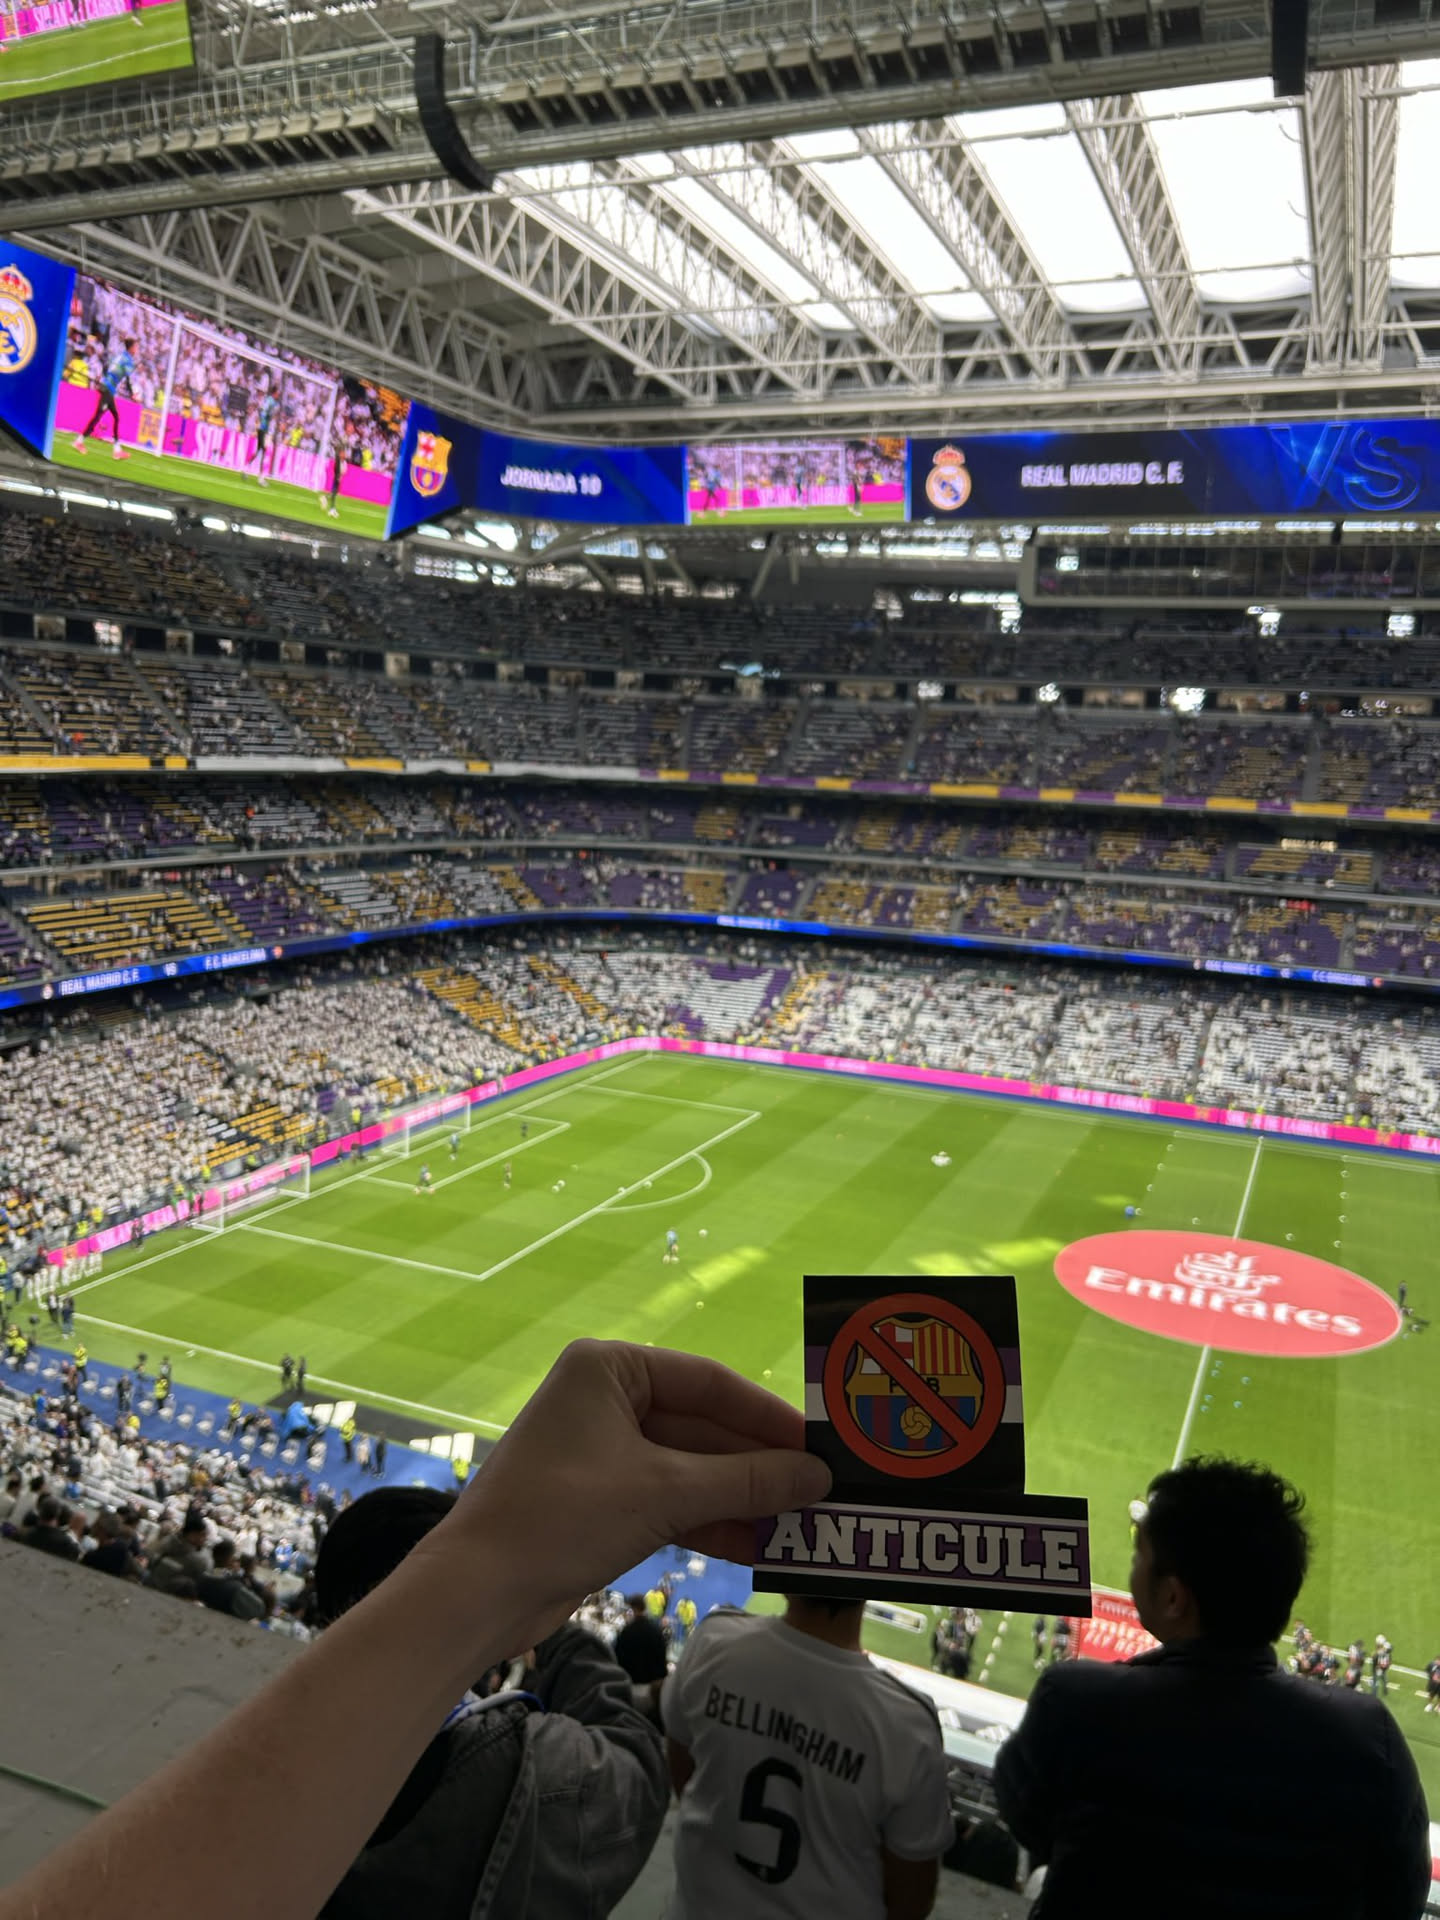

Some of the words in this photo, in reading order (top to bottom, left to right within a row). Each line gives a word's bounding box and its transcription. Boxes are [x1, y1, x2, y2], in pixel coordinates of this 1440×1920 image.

[500, 465, 578, 494] JORNADA
[1021, 464, 1068, 487] REAL
[1069, 462, 1144, 486] MADRID
[1084, 1264, 1364, 1336] Emirates
[889, 1376, 940, 1394] FB
[764, 1511, 1080, 1583] ANTICULE
[704, 1684, 867, 1785] BELLINGHAM
[734, 1756, 804, 1885] 5
